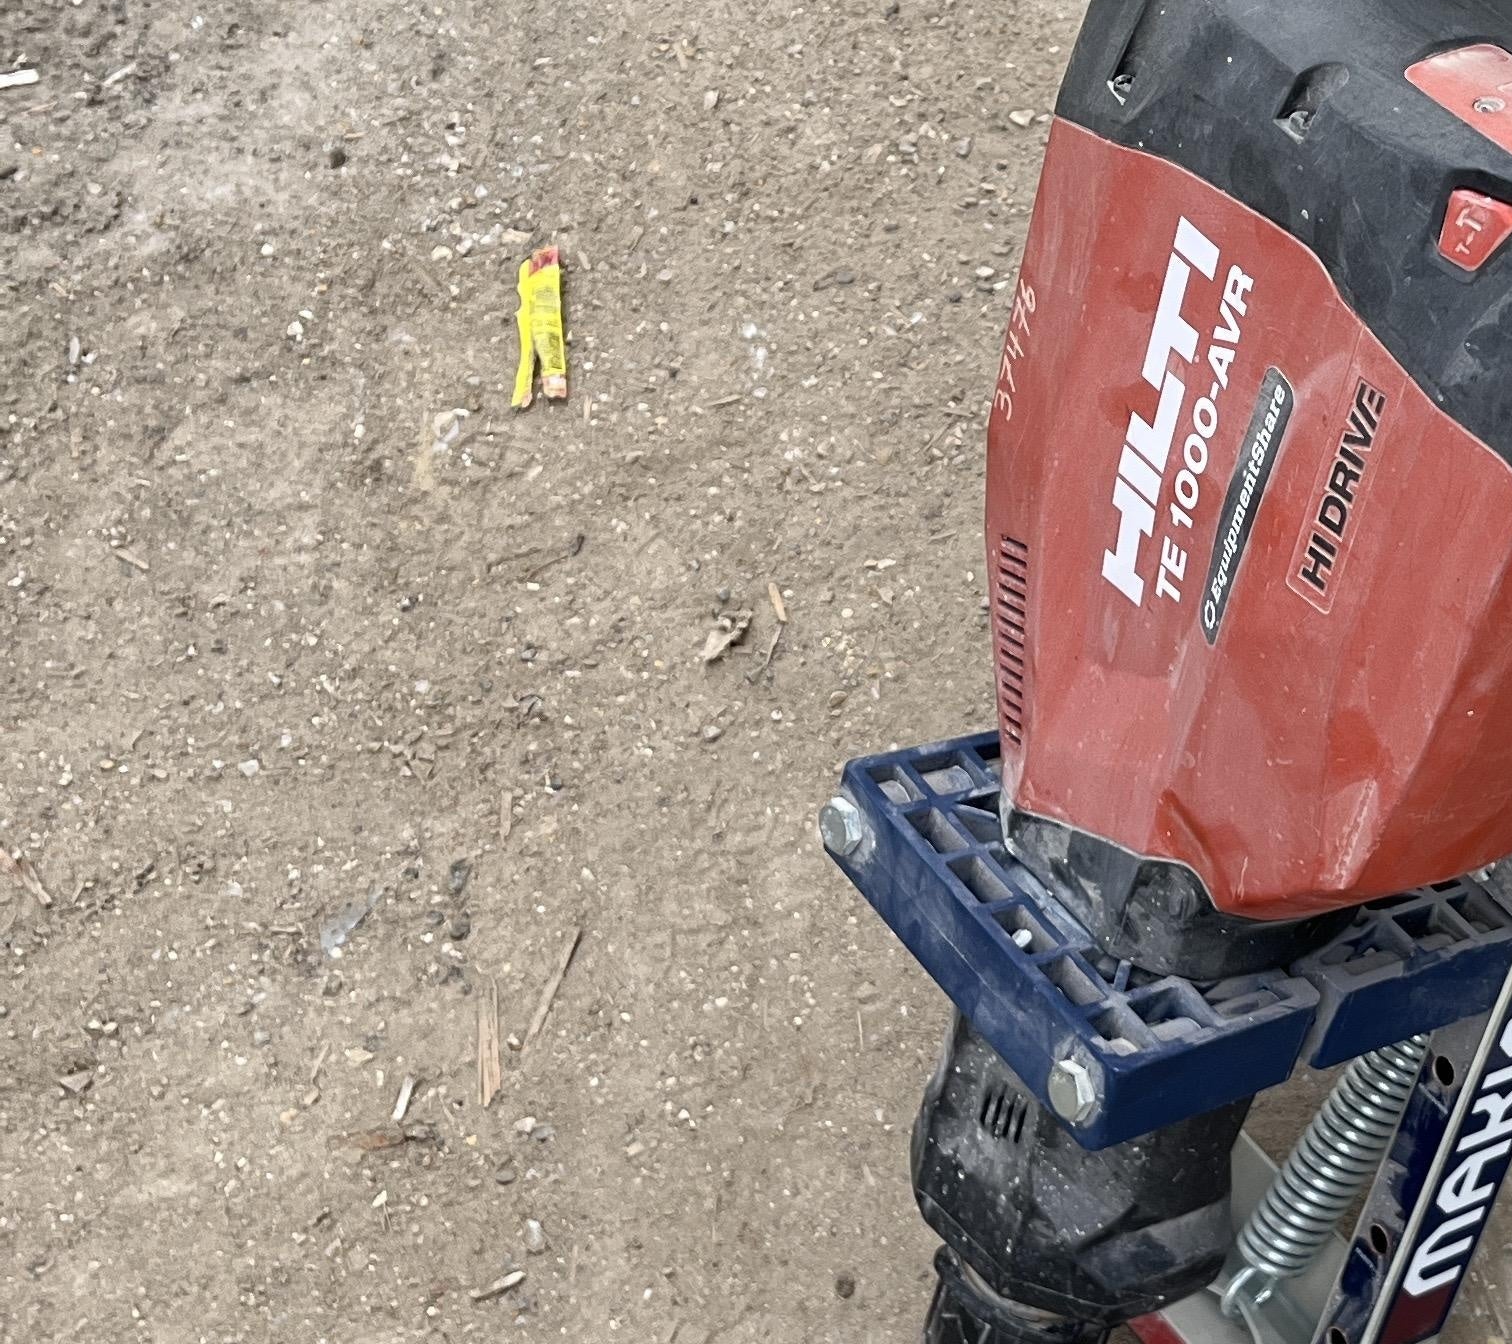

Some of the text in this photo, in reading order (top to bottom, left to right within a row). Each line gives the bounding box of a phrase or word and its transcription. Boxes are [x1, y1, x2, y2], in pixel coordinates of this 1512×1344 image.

[1101, 215, 1220, 608] HILTI
[1155, 264, 1255, 603] TE 1000-AVR
[1210, 384, 1286, 604] EquipmentShare
